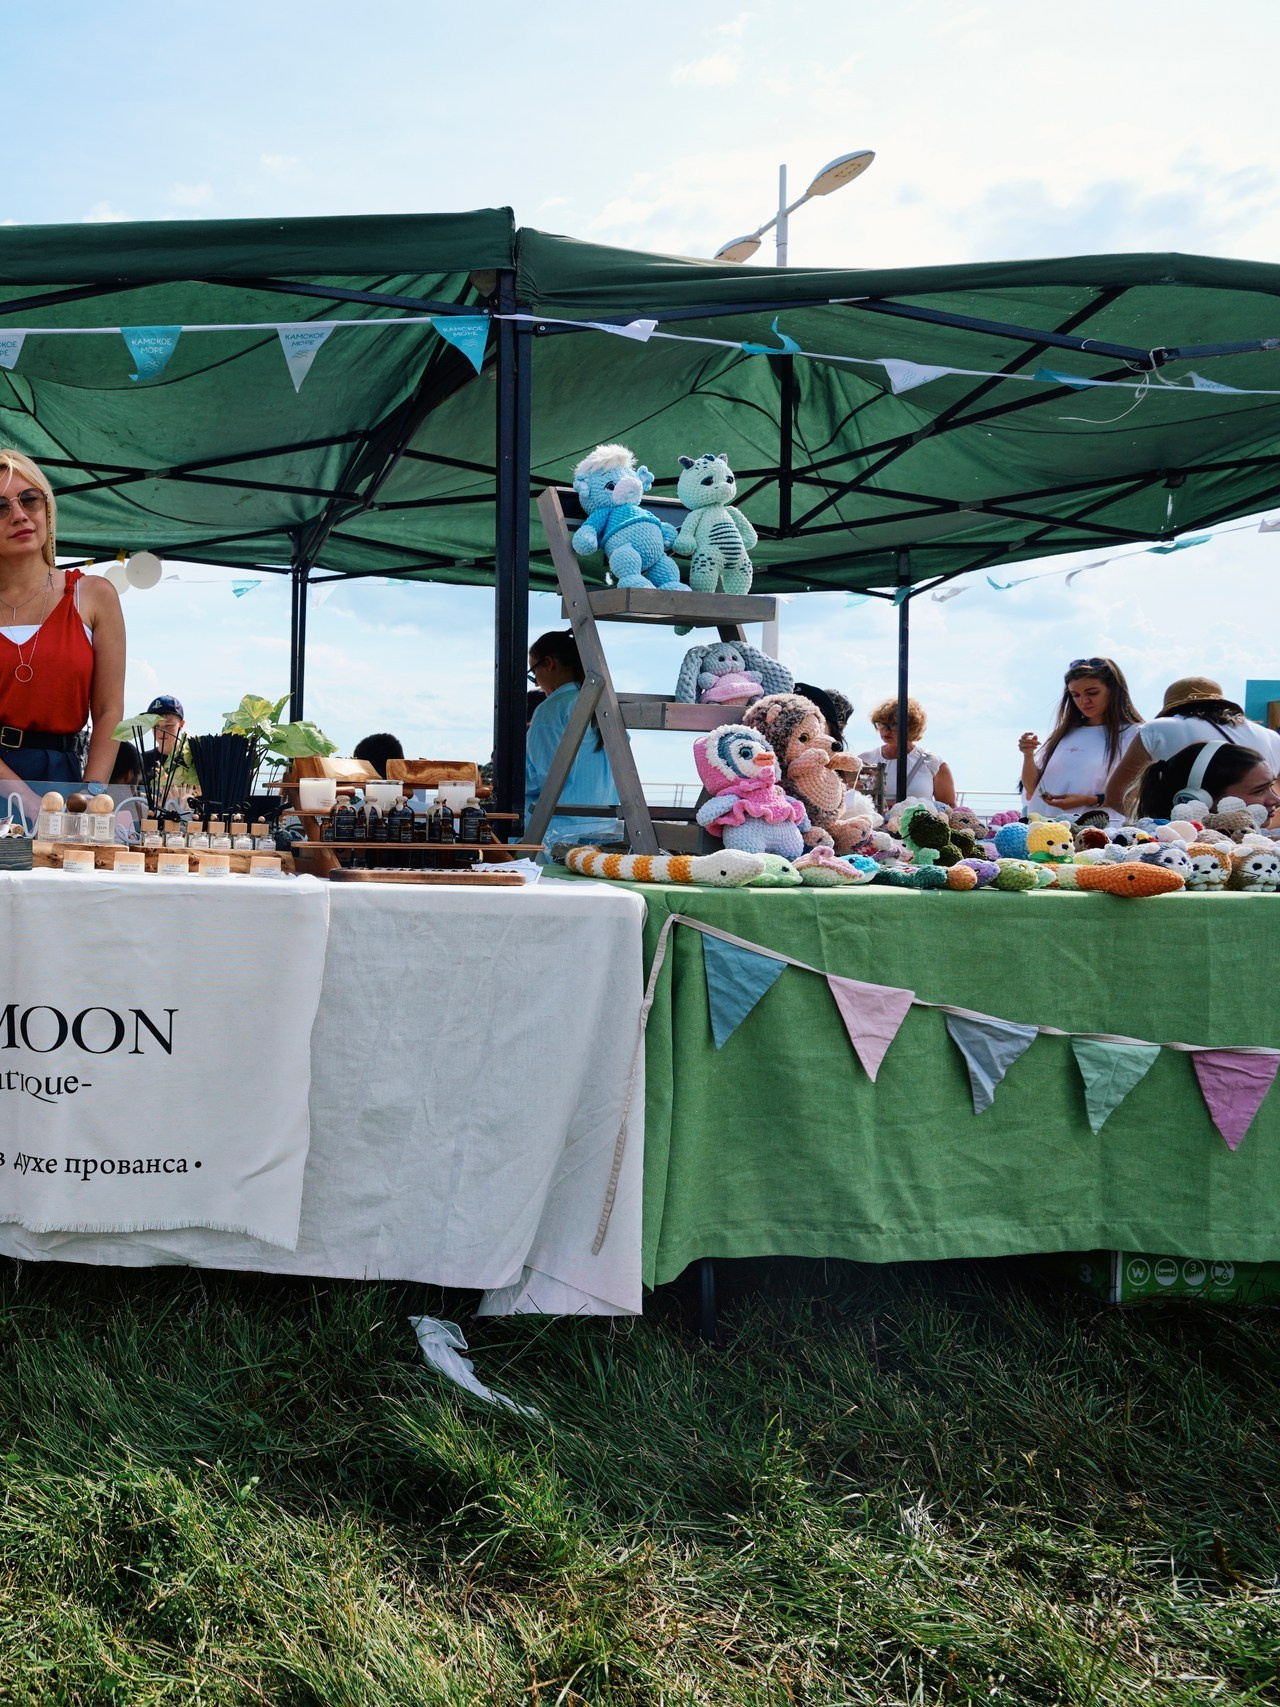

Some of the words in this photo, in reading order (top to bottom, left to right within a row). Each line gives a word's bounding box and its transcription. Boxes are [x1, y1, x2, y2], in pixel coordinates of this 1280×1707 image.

[284, 332, 325, 340] КАМСКОЕ
[131, 337, 172, 346] КАМСКОЕ
[291, 339, 315, 347] МОРЕ
[140, 346, 164, 354] МОРЕ
[13, 1151, 58, 1176] духе
[64, 1157, 189, 1182] прованса
[1190, 1263, 1197, 1273] 3
